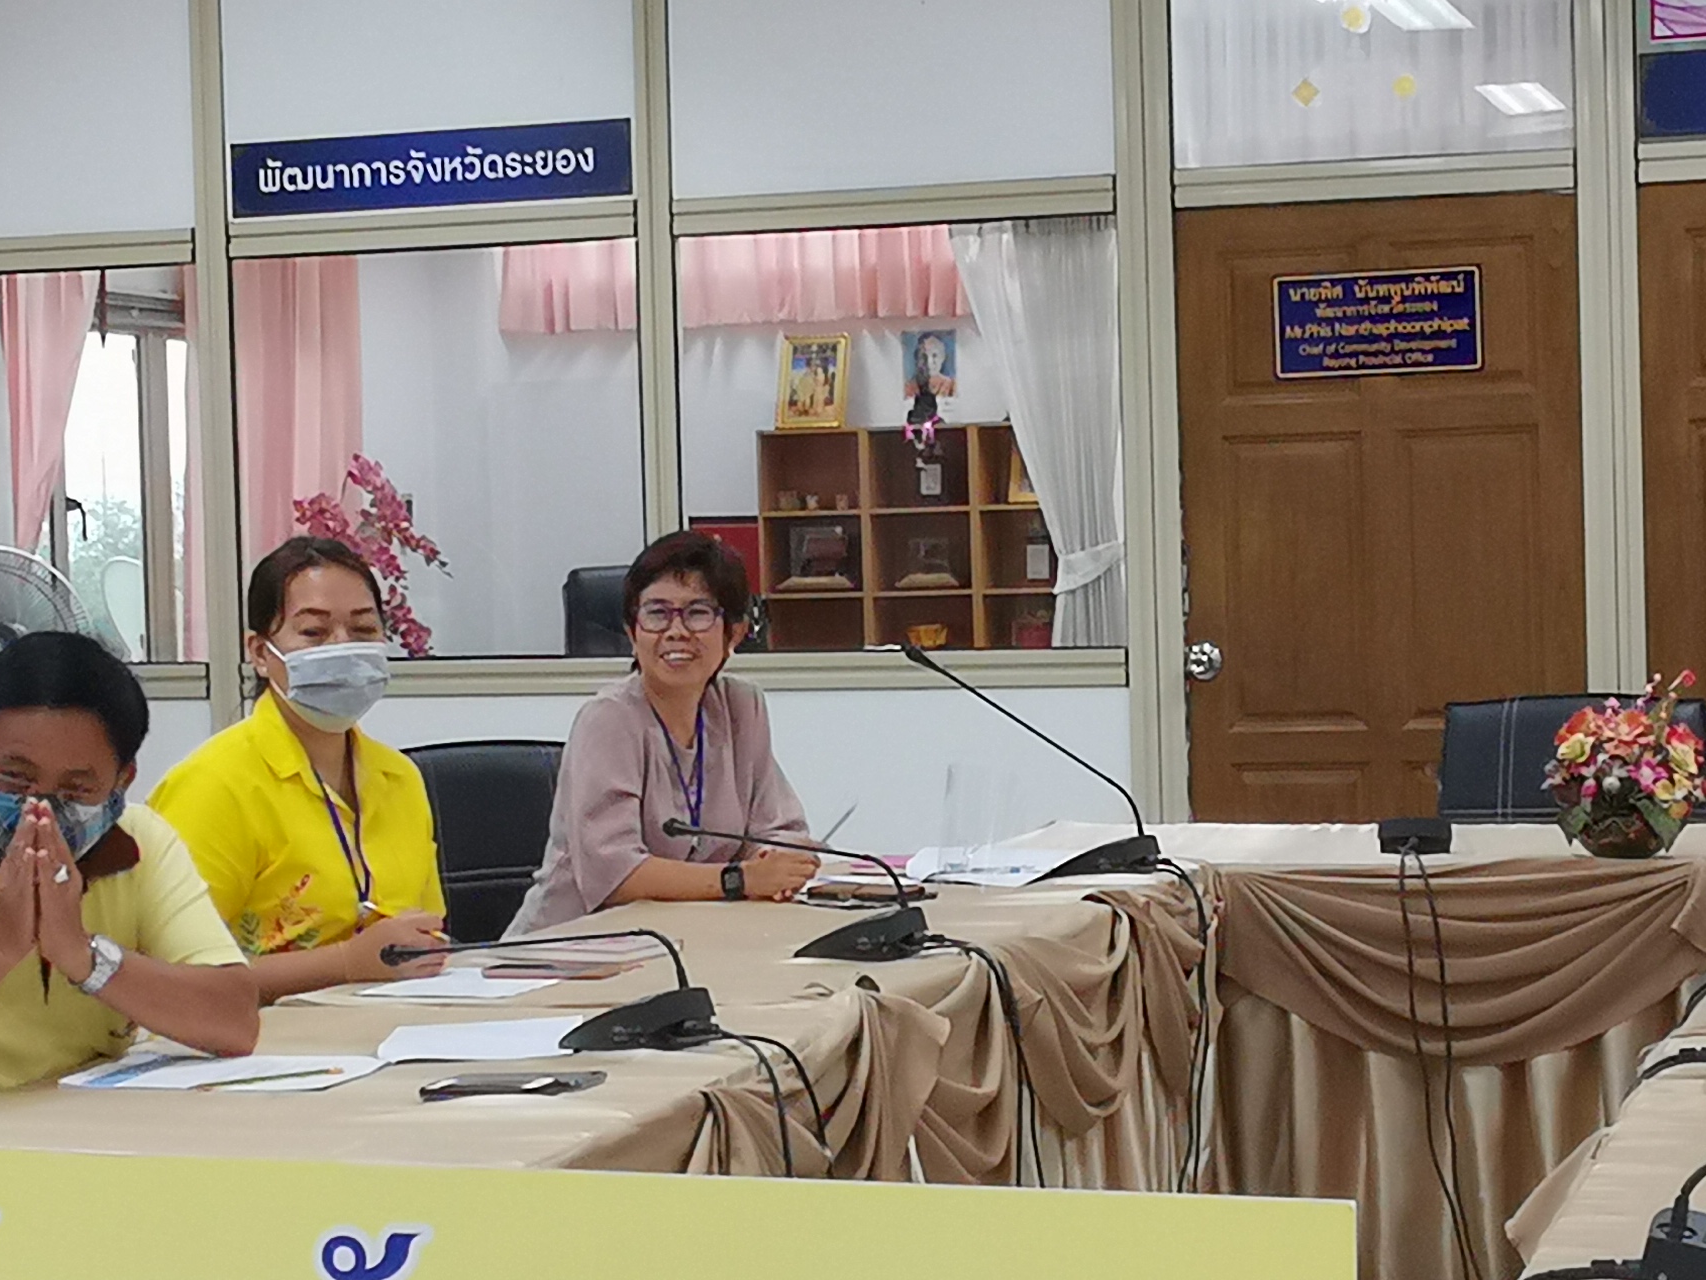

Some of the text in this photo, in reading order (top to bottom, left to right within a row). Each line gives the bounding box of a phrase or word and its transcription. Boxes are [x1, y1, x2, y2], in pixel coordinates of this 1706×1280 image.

[258, 146, 595, 193] พัฒนาการจังหวัดระยอง
